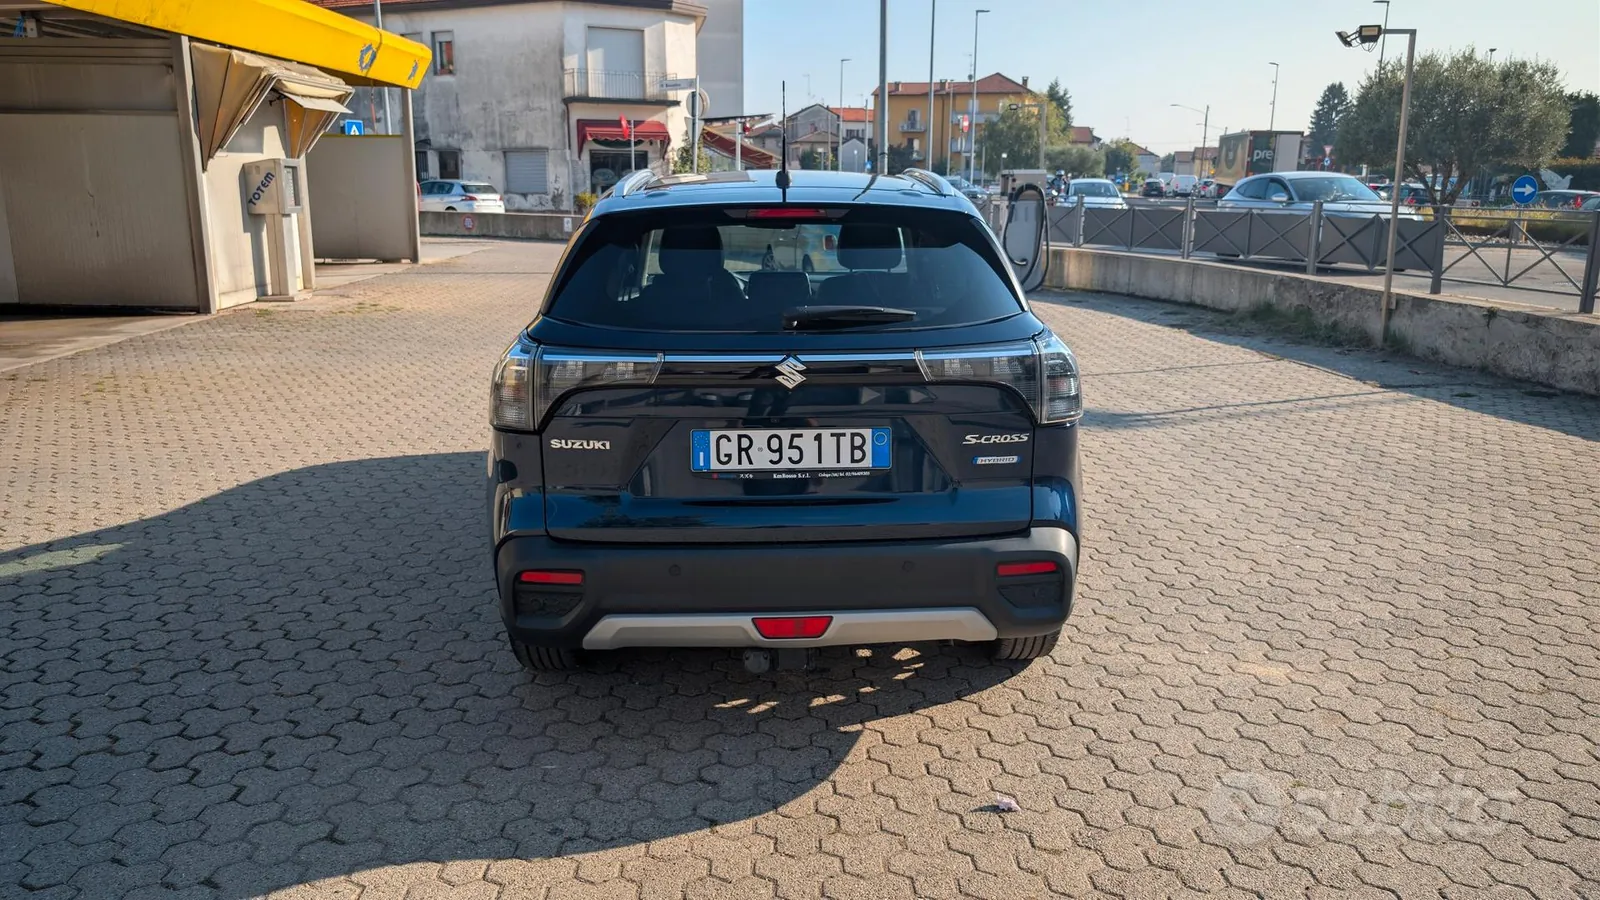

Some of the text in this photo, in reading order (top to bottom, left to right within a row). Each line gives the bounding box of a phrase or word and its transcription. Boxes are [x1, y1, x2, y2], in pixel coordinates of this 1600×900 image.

[1252, 149, 1274, 162] pre
[248, 172, 275, 206] TOTEM
[550, 439, 611, 450] SUZUKI
[962, 433, 1030, 445] S-CROSS
[715, 433, 754, 466] GR
[980, 456, 1016, 464] HYBRID
